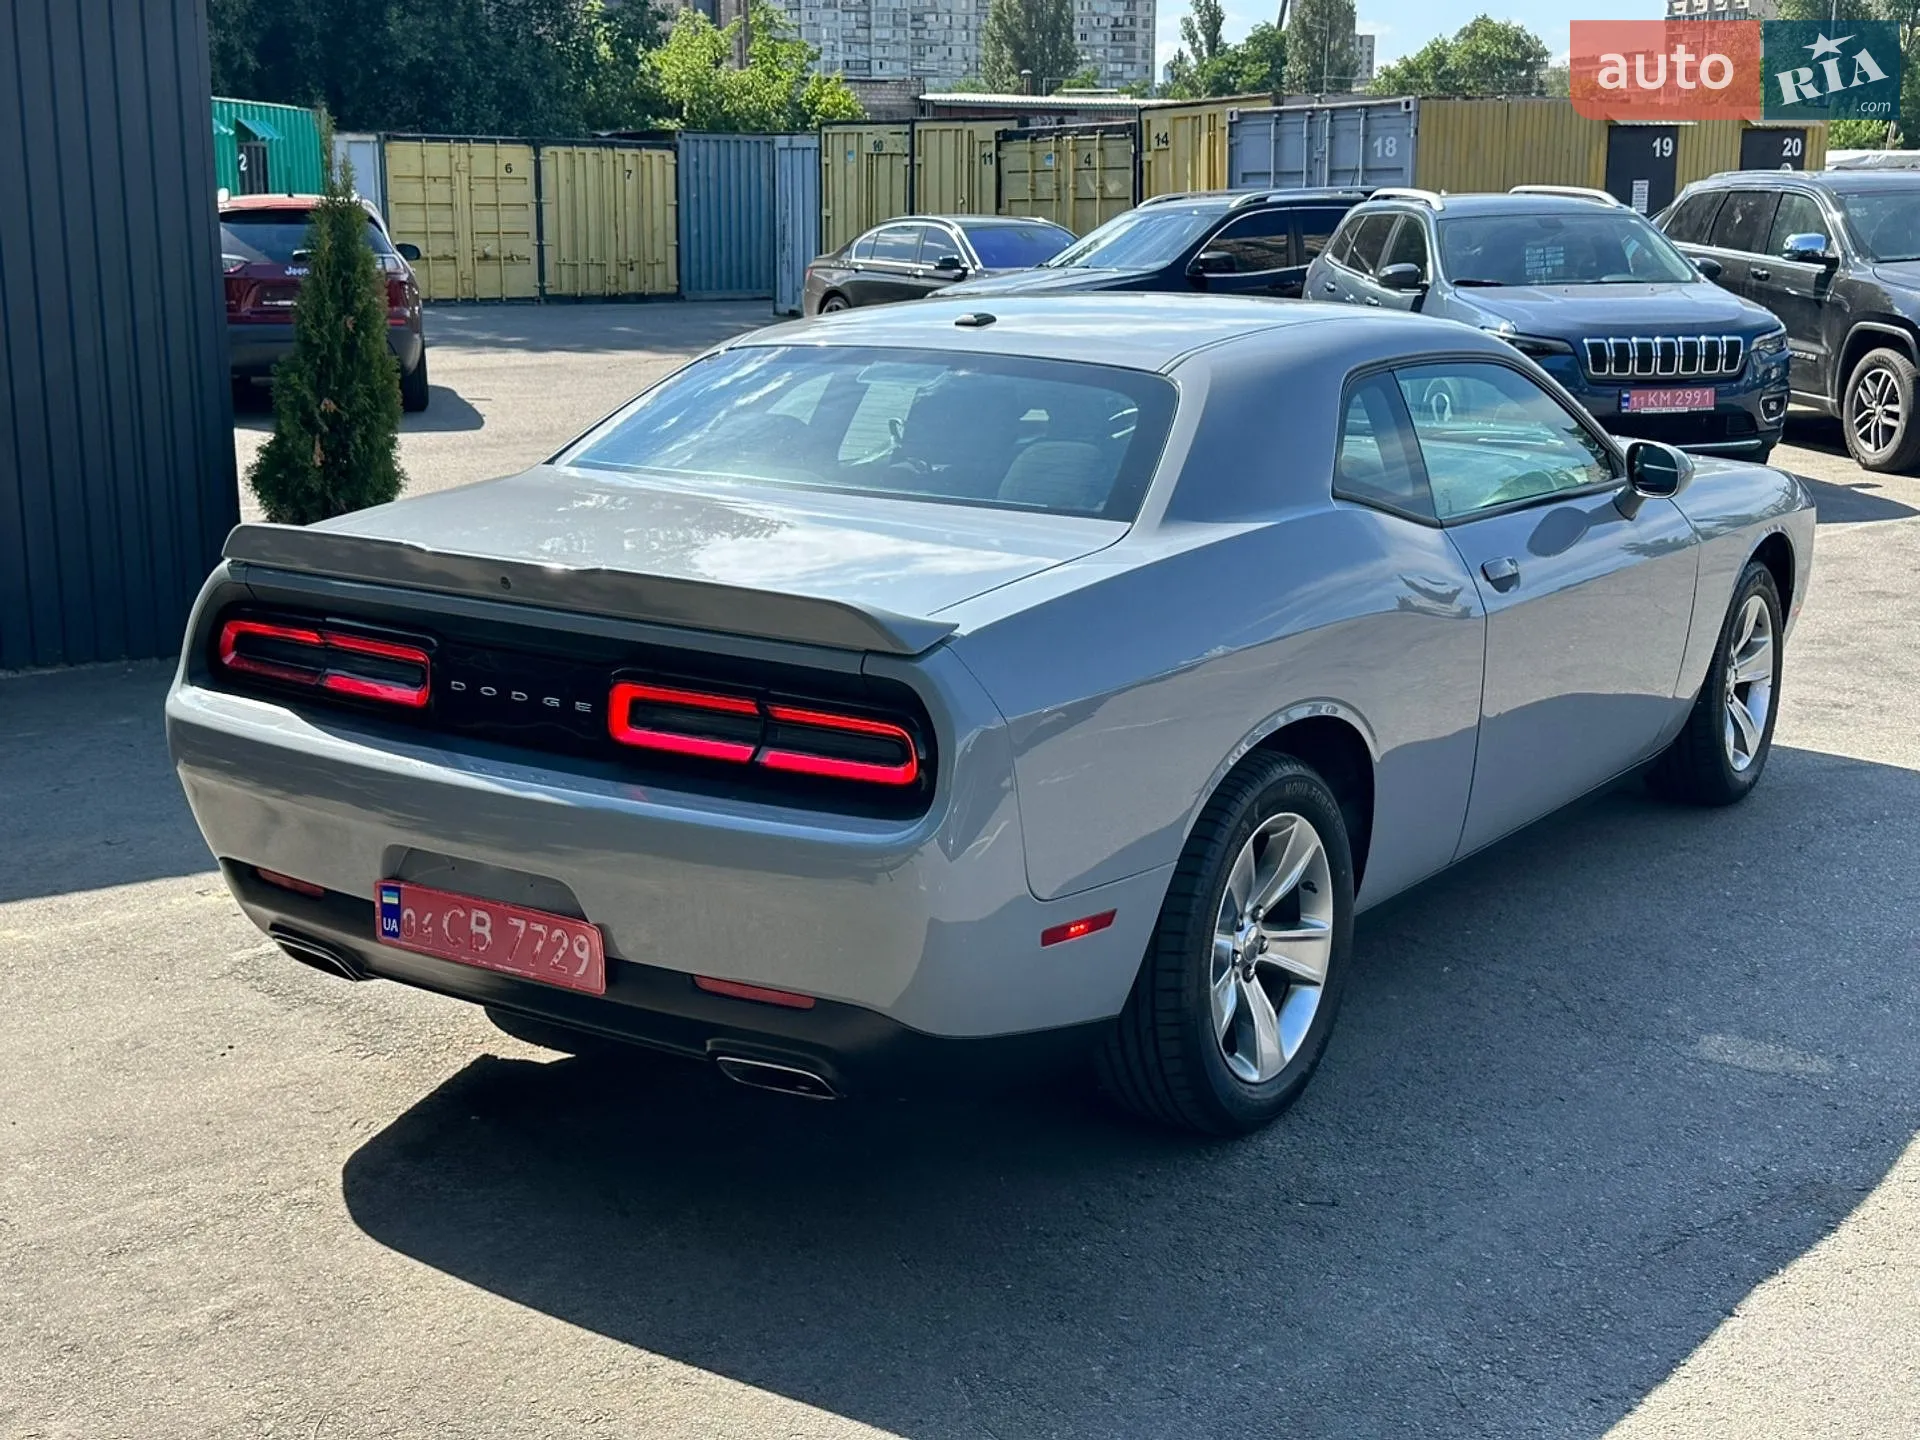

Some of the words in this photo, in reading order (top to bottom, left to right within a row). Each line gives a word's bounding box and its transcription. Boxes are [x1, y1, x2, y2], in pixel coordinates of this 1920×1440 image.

[1154, 131, 1170, 147] 14
[1372, 135, 1398, 158] 18
[1652, 136, 1674, 158] 19
[1782, 137, 1803, 157] 20
[238, 152, 248, 171] 2
[981, 151, 994, 166] 11
[1083, 152, 1092, 167] 4
[504, 162, 514, 174] 6
[624, 169, 633, 180] 7
[450, 680, 593, 713] DODGE
[382, 916, 399, 933] UA
